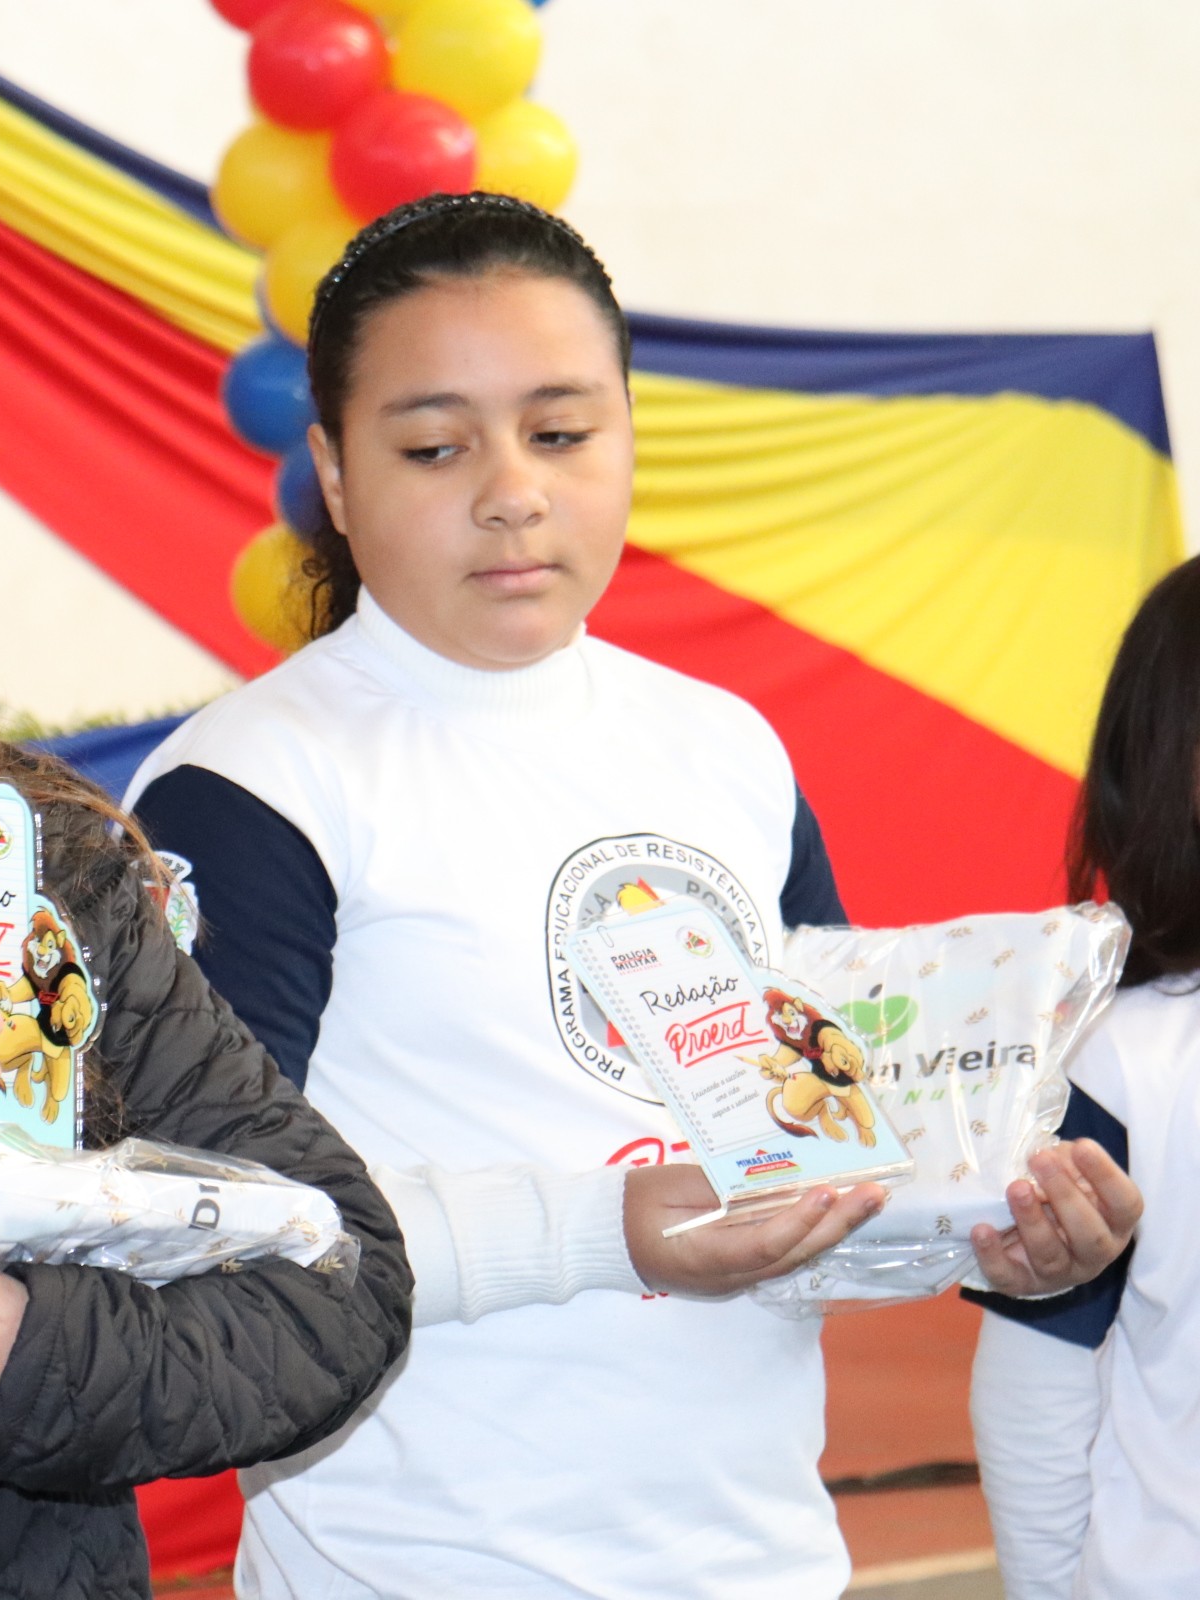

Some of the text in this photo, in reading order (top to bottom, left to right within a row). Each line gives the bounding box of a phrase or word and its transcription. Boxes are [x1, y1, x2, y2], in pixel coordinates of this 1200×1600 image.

[557, 968, 626, 1082] PROGRAMA
[614, 843, 641, 858] DE
[646, 842, 757, 935] RESISTÊNCIA
[615, 955, 659, 971] MILITAR
[639, 975, 739, 1016] Redação
[664, 1003, 765, 1065] Proerd
